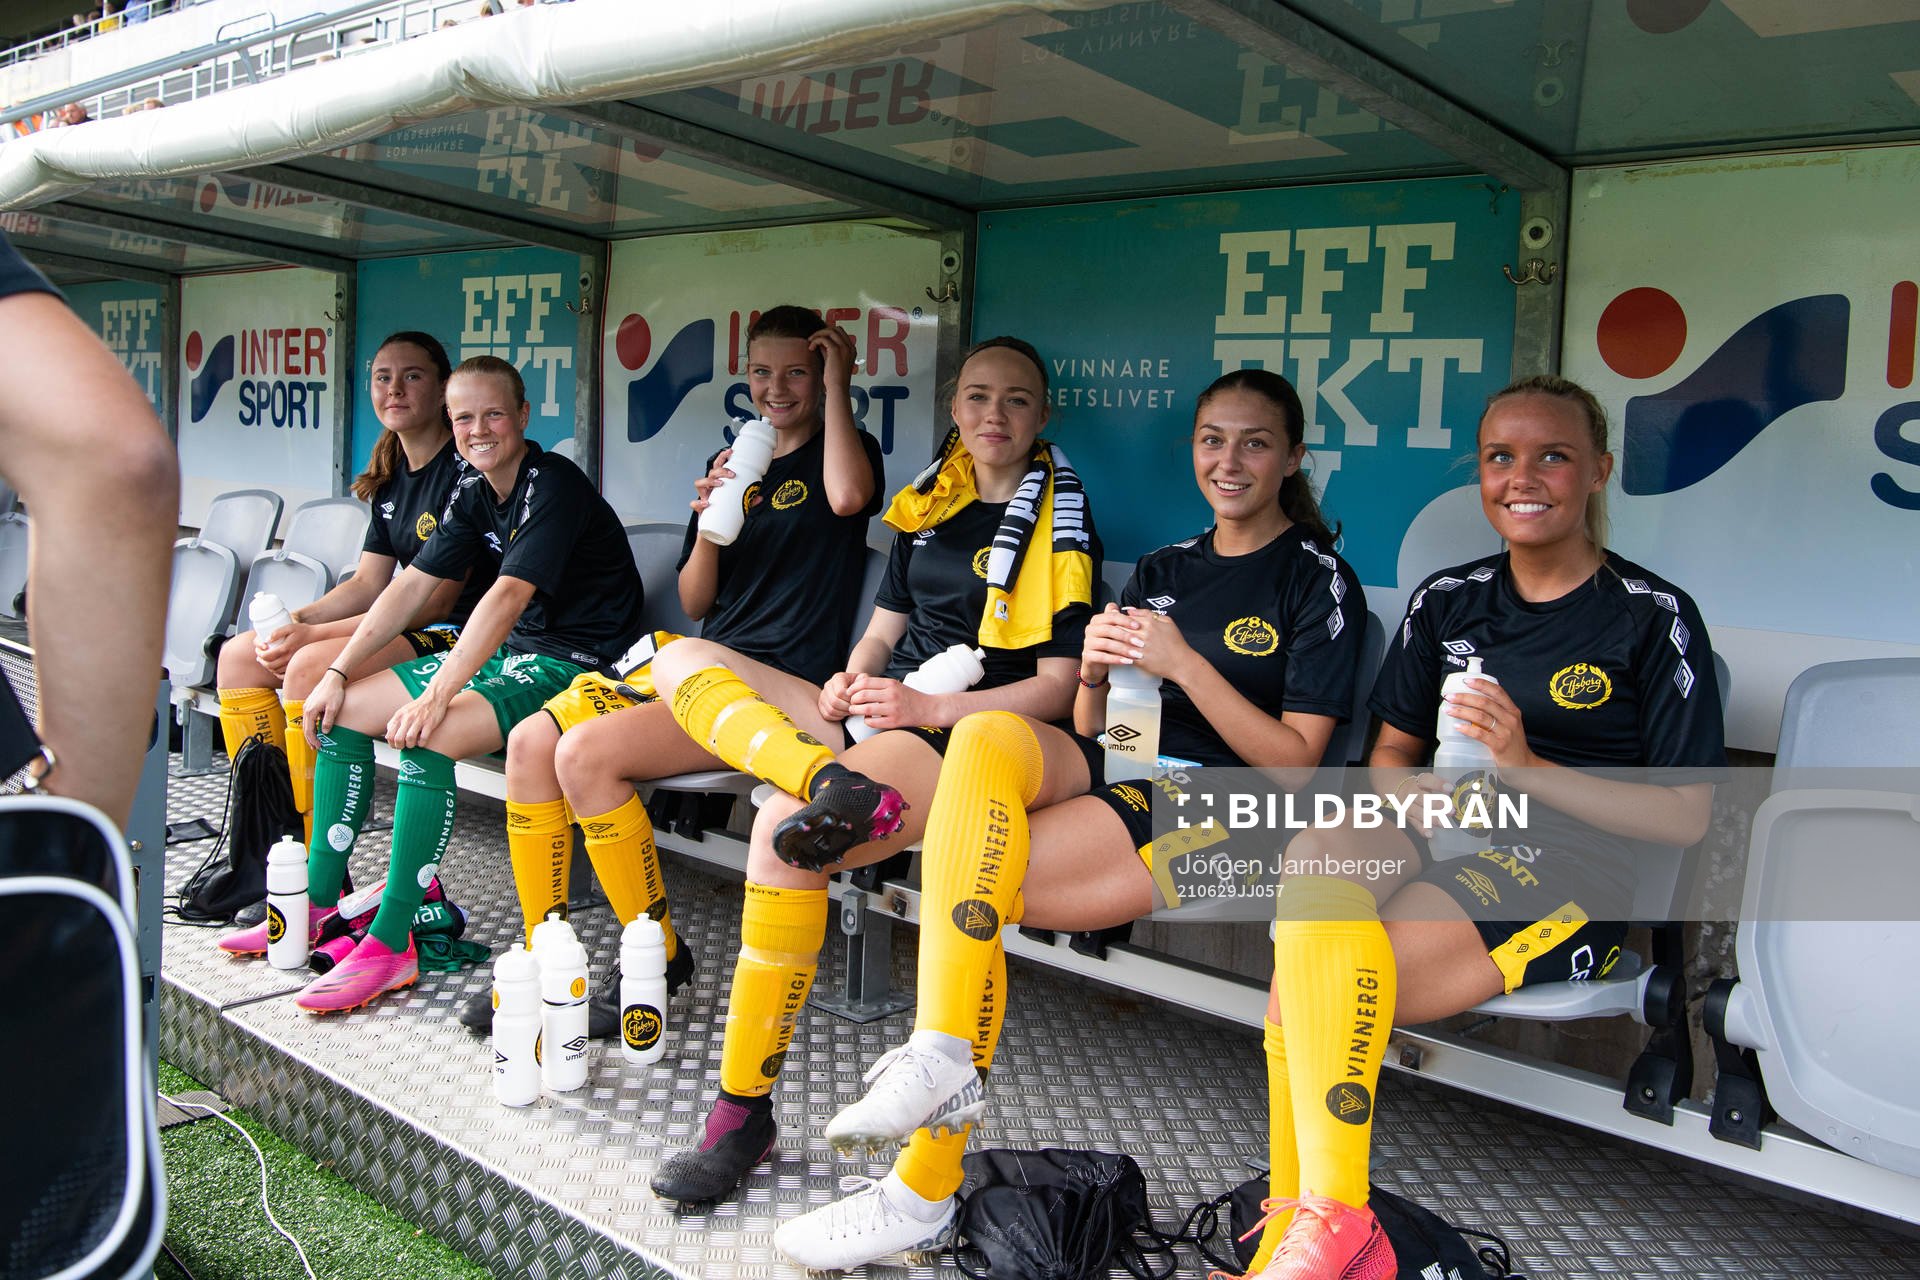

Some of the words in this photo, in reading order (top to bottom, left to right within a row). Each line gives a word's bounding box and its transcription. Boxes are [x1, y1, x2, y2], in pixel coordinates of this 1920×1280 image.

[1214, 222, 1457, 334] EFF
[101, 299, 158, 350] EFF
[461, 273, 562, 344] EFF
[241, 327, 327, 376] INTER
[1053, 359, 1171, 379] VINNARE
[238, 380, 327, 429] SPORT
[1048, 387, 1176, 409] ETSLIVET
[1230, 626, 1272, 646] Elfsborg
[1557, 673, 1602, 699] Elfsborg
[1108, 743, 1137, 753] umbro
[342, 763, 364, 823] VINNERG
[1110, 787, 1140, 813] umbro
[433, 790, 455, 862] VINNERGI
[975, 799, 1010, 896] VINNERGI
[552, 833, 566, 903] VINNERGI
[640, 837, 659, 901] VINNERGI
[1455, 872, 1490, 907] umbro
[627, 1020, 655, 1039] Elfsborg
[777, 971, 808, 1051] VINNERGI
[1346, 968, 1379, 1078] VINNERGI
